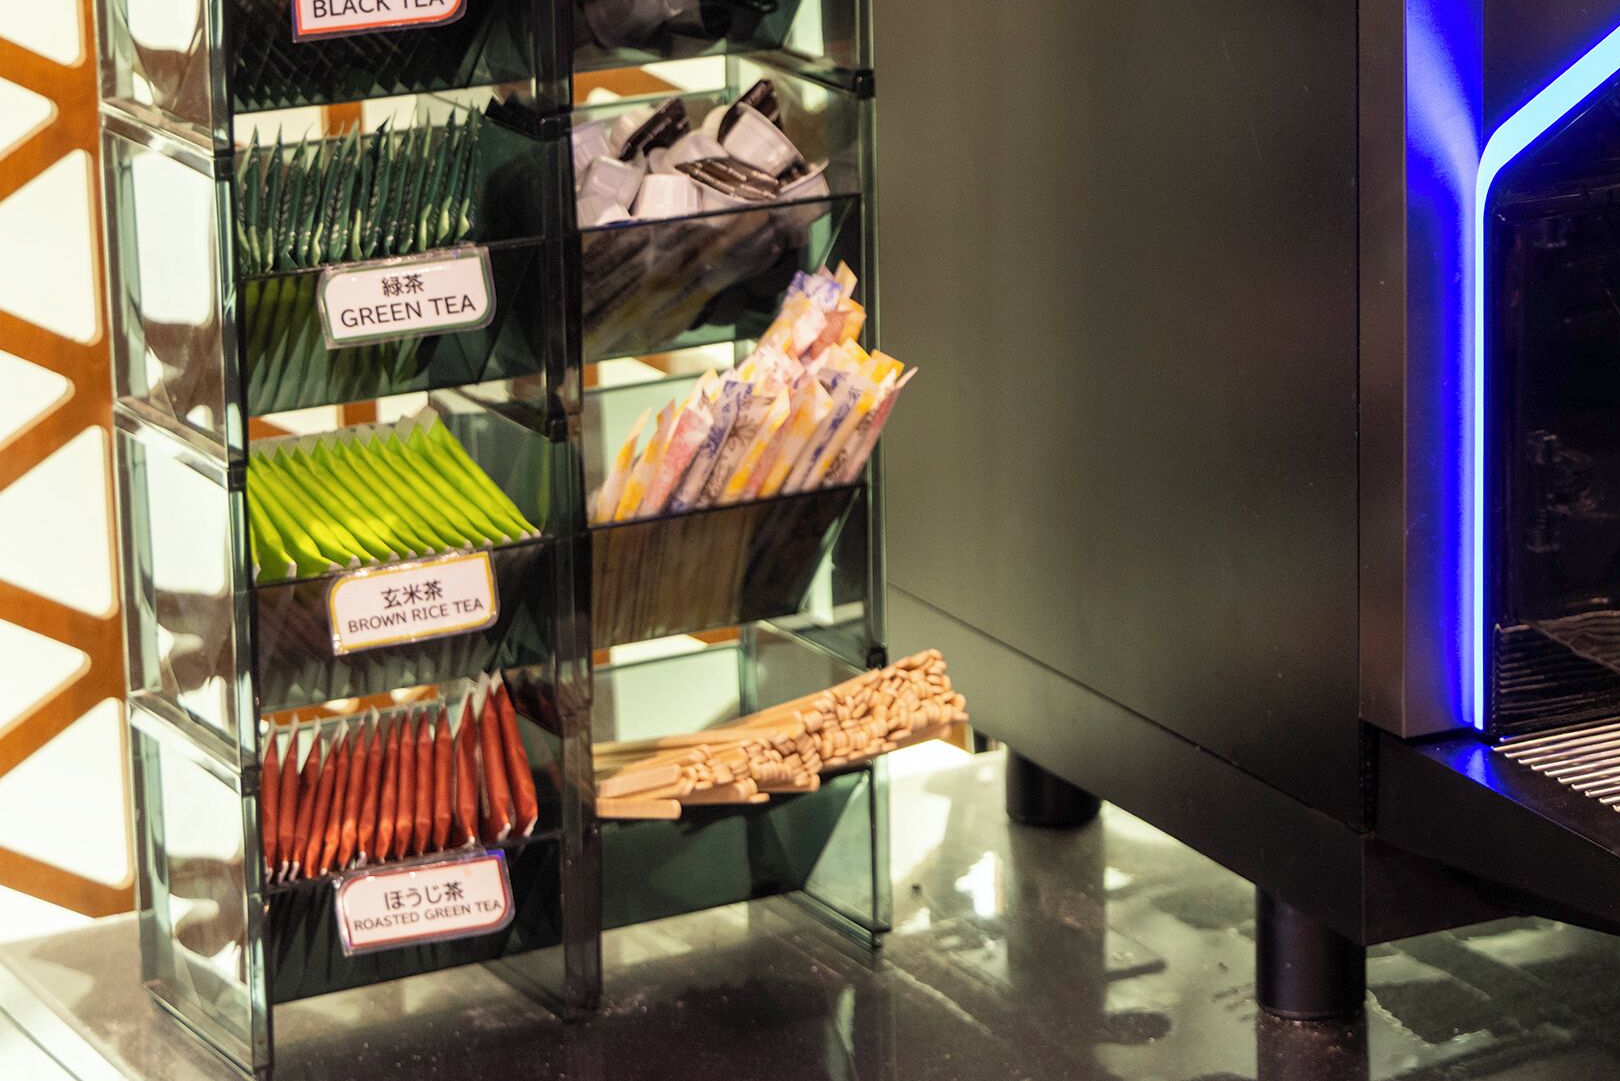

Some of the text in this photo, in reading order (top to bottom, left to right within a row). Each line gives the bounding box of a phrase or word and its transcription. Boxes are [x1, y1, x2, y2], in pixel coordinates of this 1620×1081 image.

[382, 274, 424, 297] 緑茶
[340, 294, 477, 328] GREEN TEA
[381, 580, 443, 609] 玄米茶
[348, 598, 485, 633] BROWN RICE TEA
[384, 880, 464, 910] ほうじ茶
[354, 899, 502, 931] ROASTED GREEN TEA
